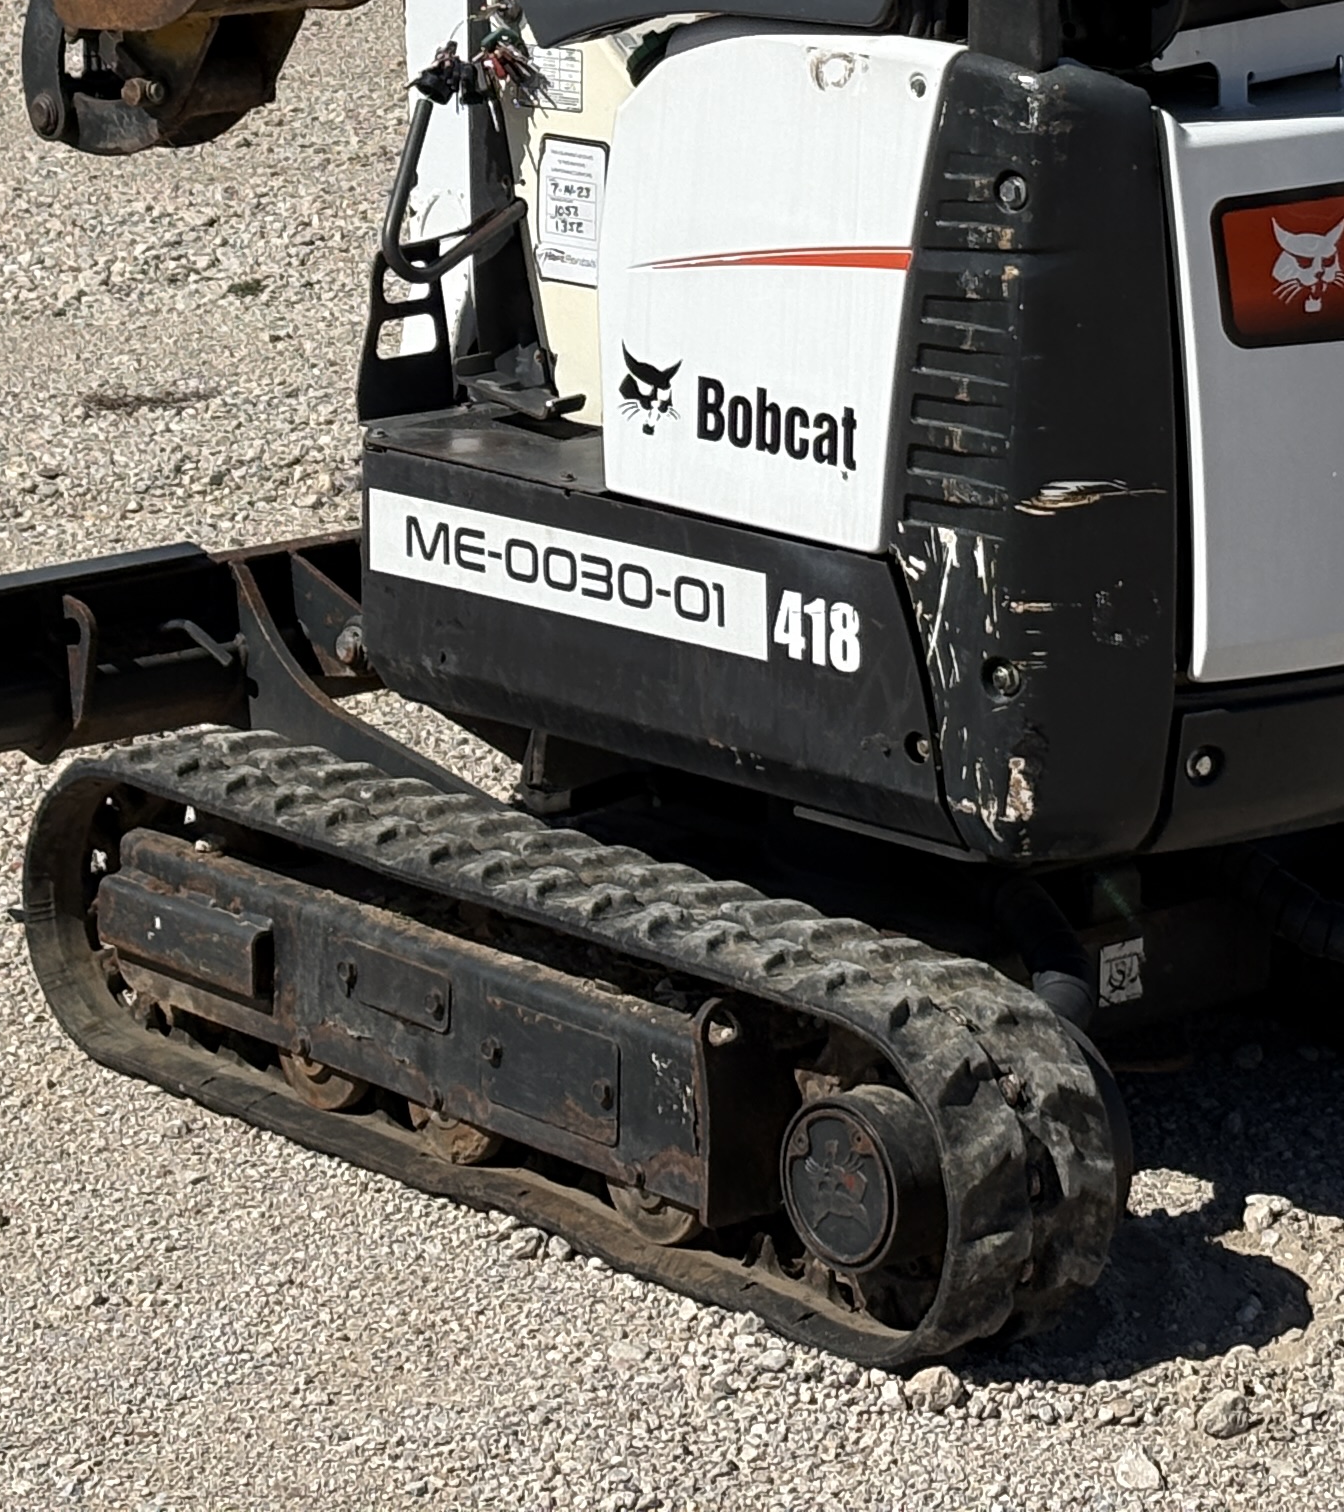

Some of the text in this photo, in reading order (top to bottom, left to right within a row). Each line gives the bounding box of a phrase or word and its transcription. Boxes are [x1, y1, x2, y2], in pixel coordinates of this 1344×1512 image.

[697, 375, 856, 471] Bobcat
[406, 515, 725, 627] ME-0030-01
[773, 589, 862, 673] 418
